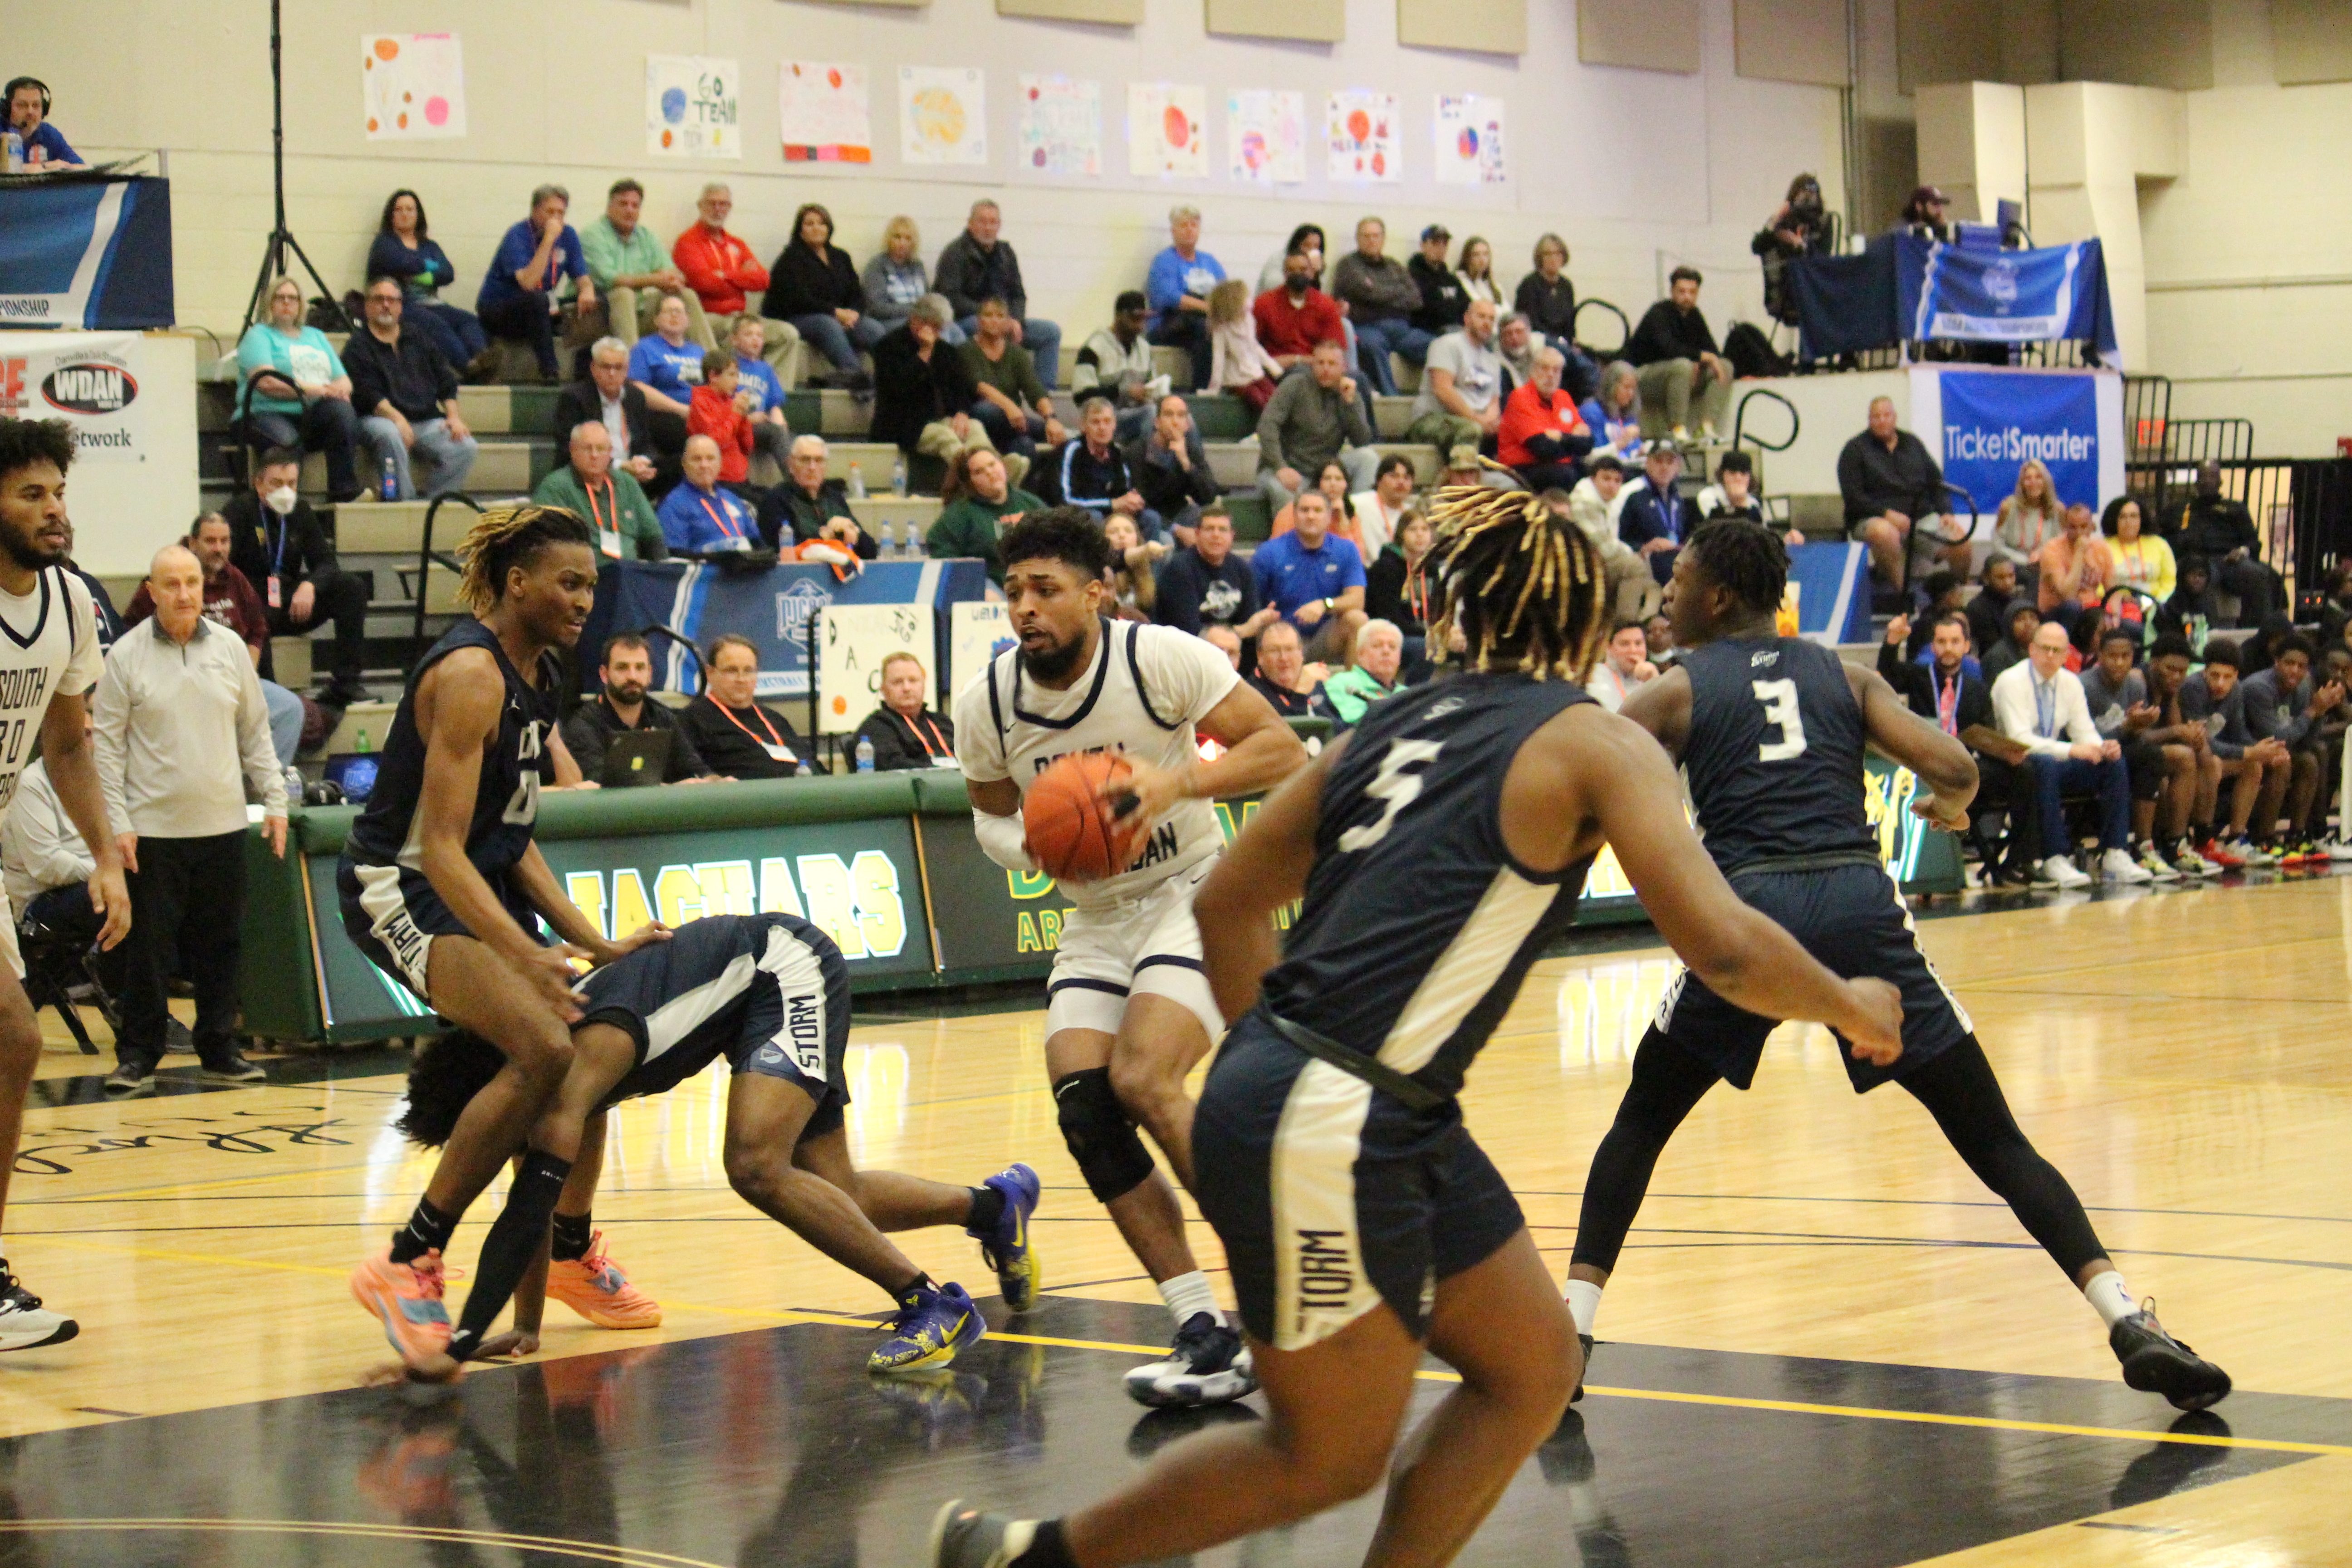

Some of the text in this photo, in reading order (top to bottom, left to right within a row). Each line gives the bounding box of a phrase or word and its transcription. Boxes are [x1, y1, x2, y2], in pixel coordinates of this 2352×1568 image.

[698, 73, 722, 100] GO
[692, 96, 736, 125] TEAM
[0, 299, 49, 317] IONSHIP
[54, 370, 123, 401] WDAN
[1945, 425, 2093, 461] TicketSmarter
[1752, 678, 1807, 763] 3
[1338, 736, 1446, 853] 5
[565, 849, 907, 976] JAGUARS
[789, 995, 820, 1070] STORM
